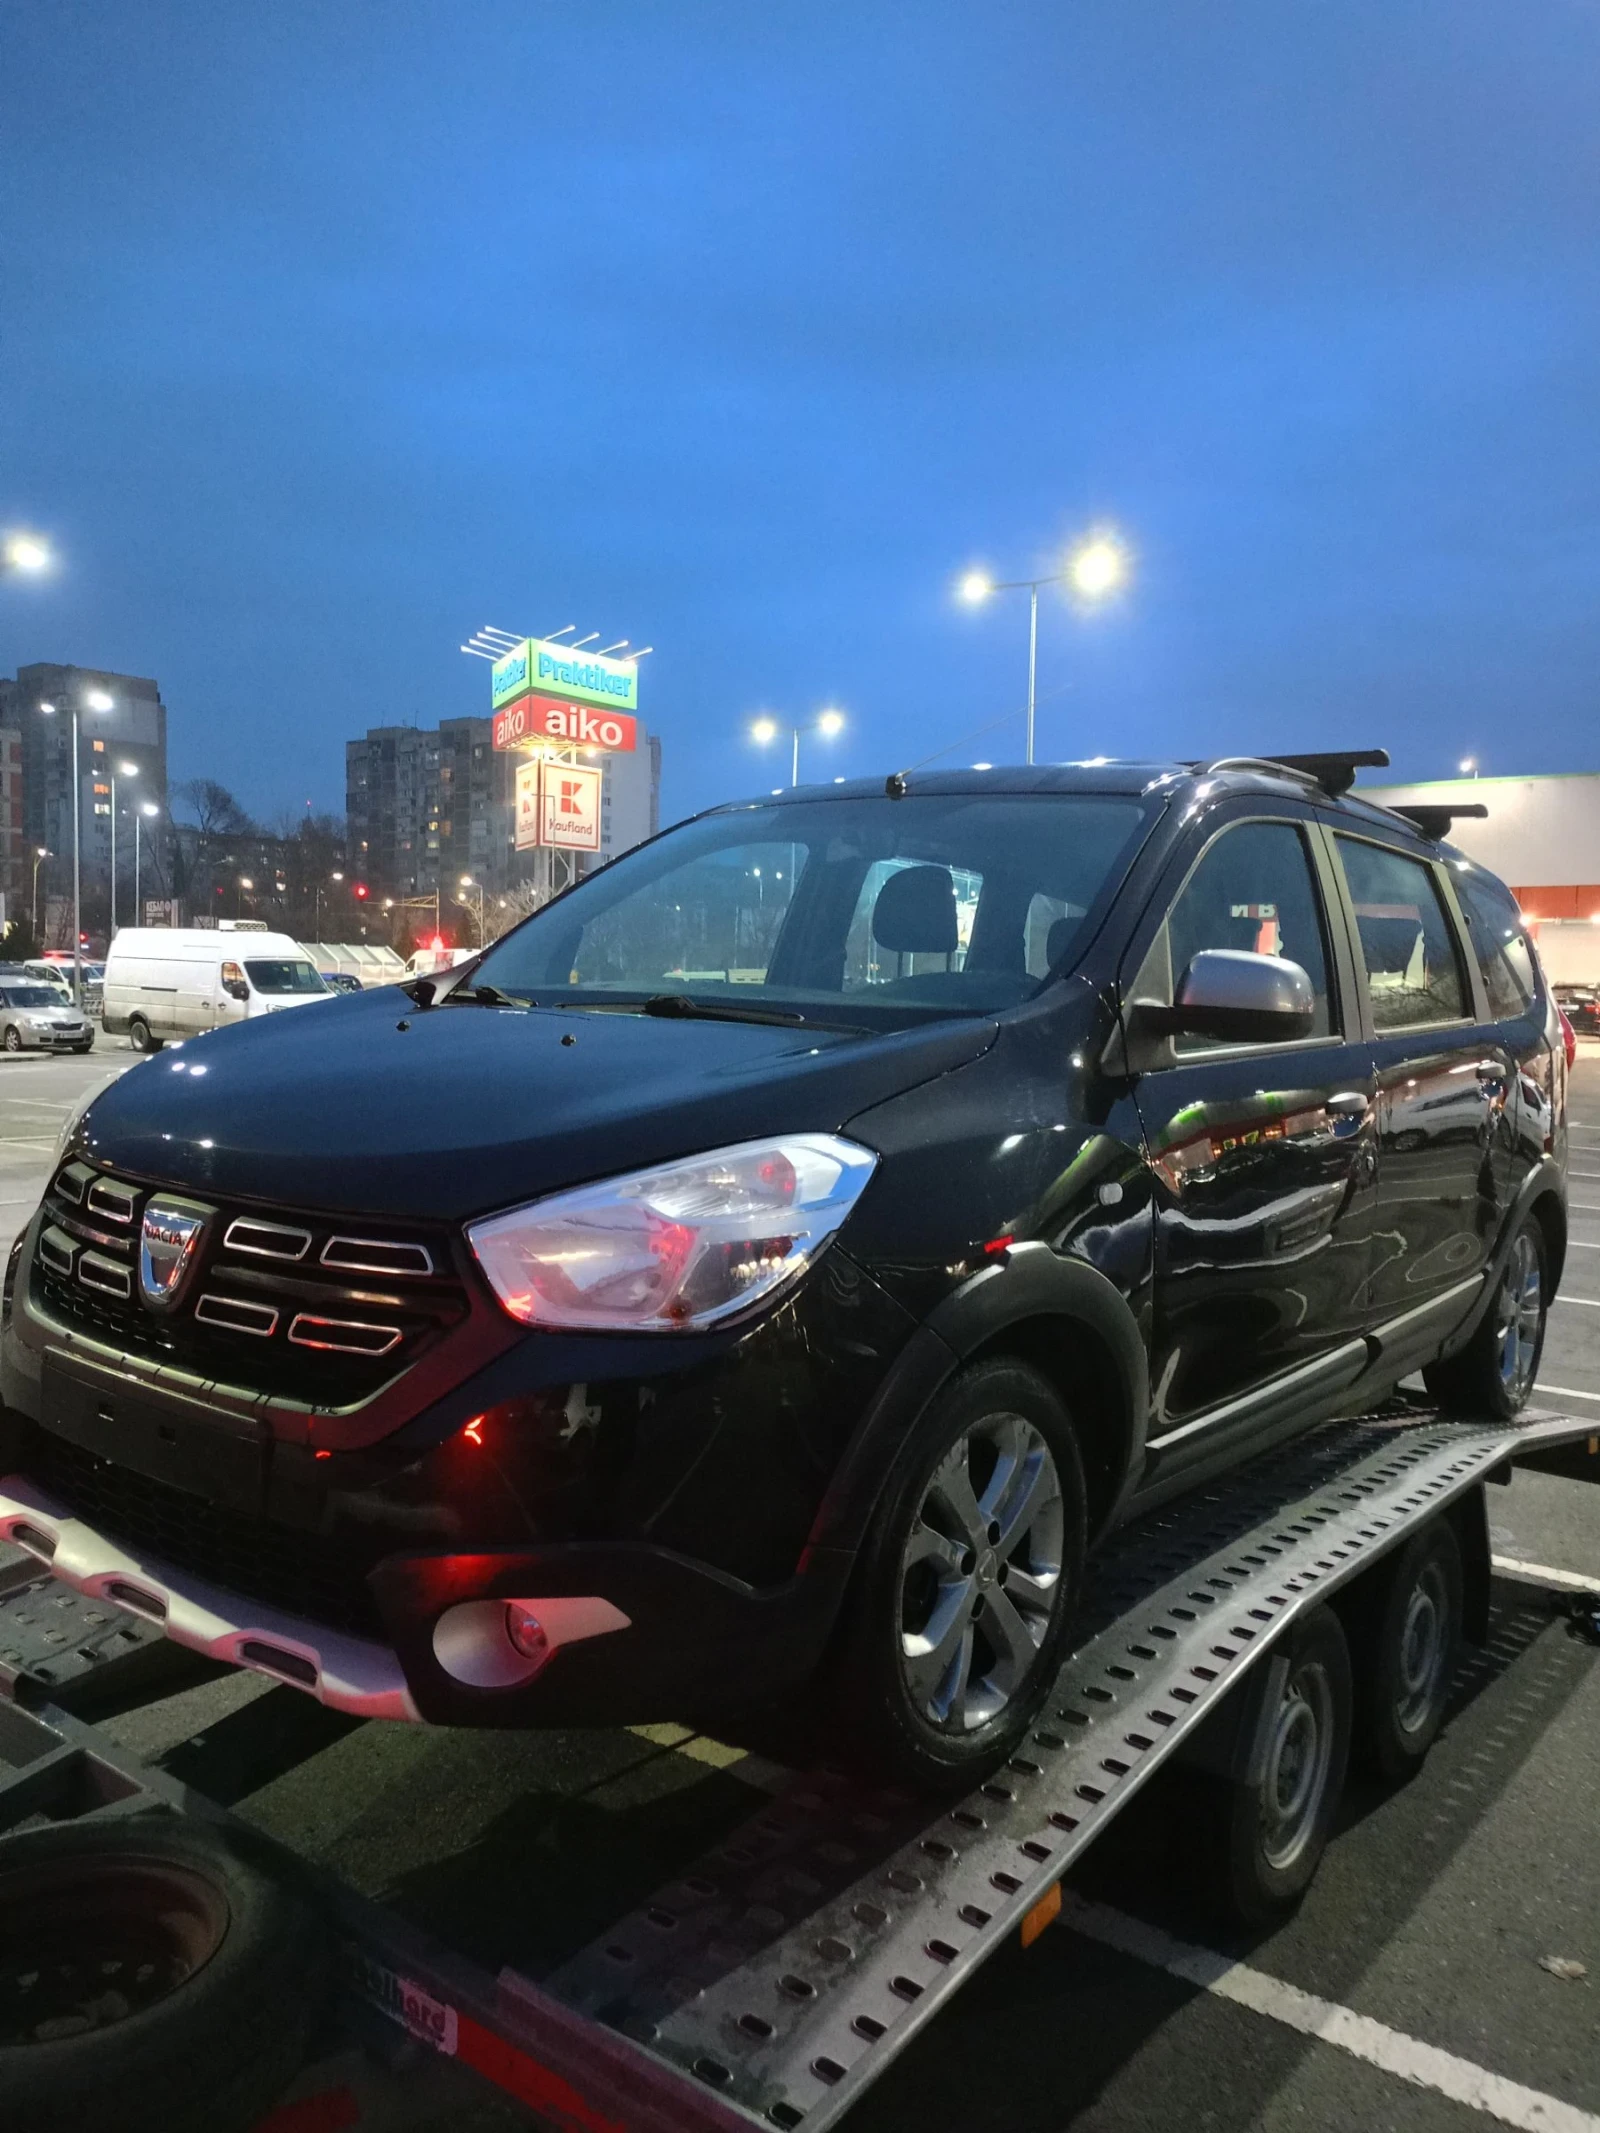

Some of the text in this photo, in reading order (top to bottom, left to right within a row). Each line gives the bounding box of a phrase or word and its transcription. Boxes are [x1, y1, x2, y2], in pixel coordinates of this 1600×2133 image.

[539, 652, 632, 697] Praktiker
[497, 709, 525, 745] aiko
[545, 706, 623, 746] aiko
[549, 818, 593, 835] Kaufland
